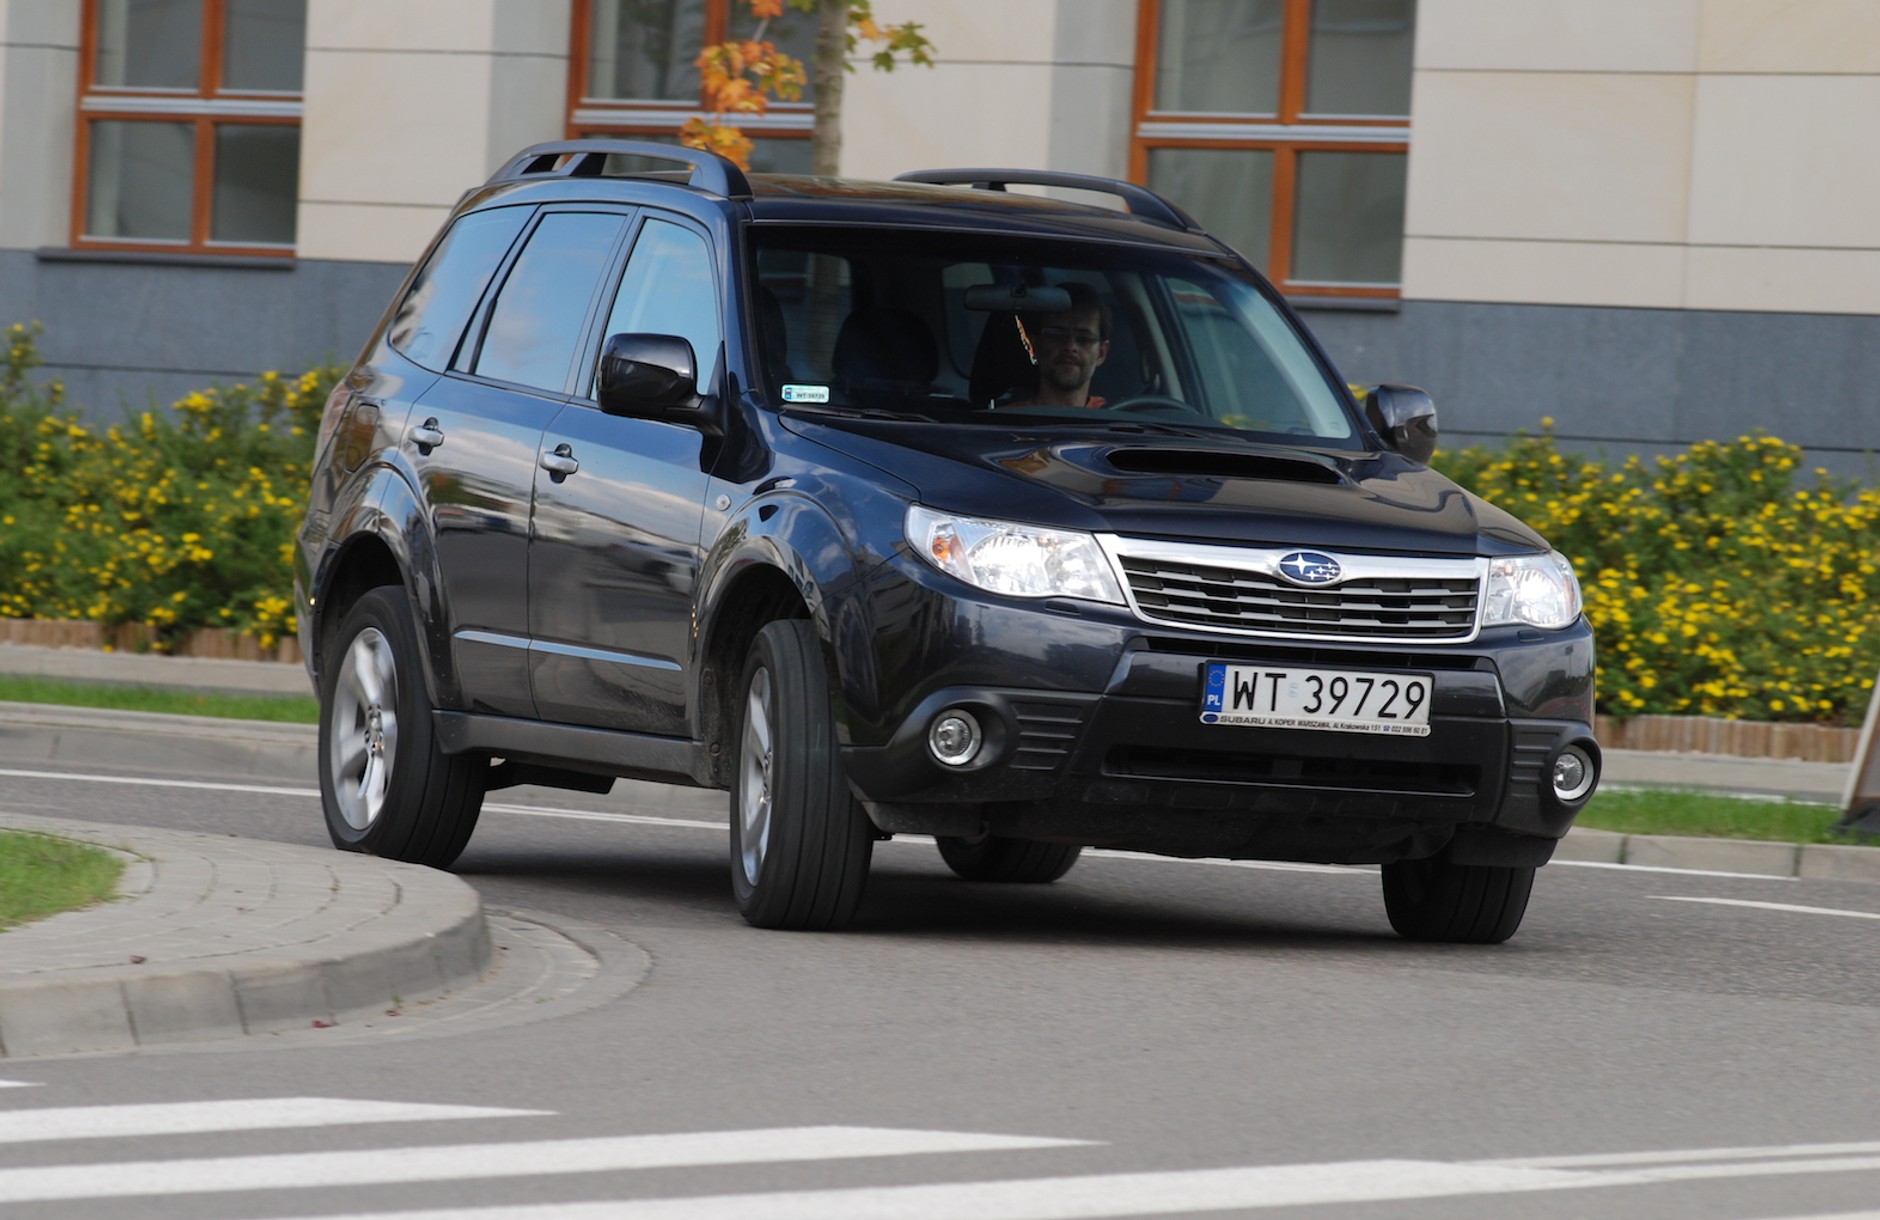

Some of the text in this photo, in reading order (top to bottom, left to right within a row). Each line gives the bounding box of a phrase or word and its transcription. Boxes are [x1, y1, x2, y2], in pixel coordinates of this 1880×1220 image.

[1206, 694, 1221, 707] PL
[1233, 671, 1425, 720] WT 39729
[1220, 715, 1266, 726] SUBARU
